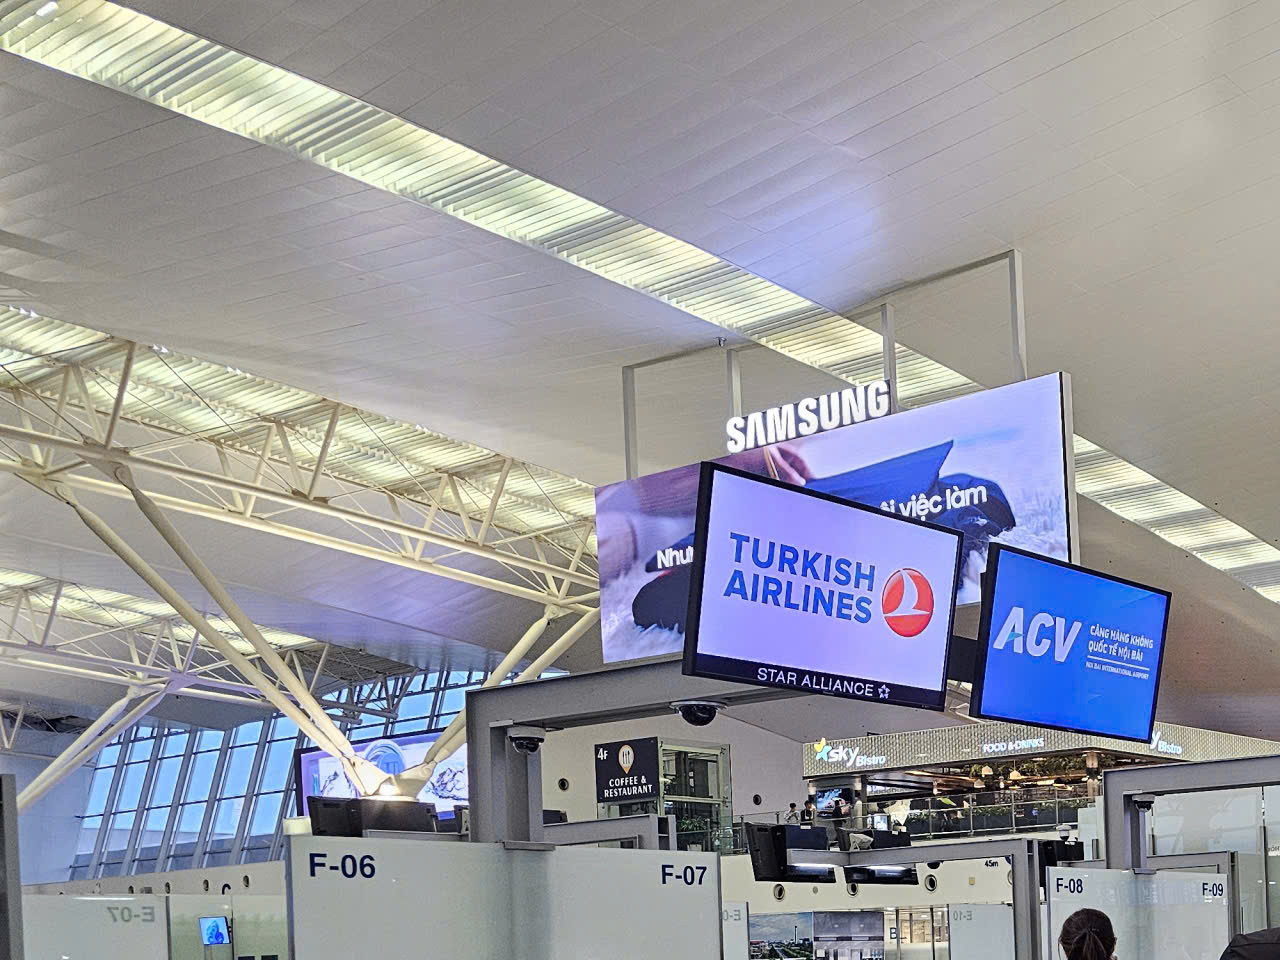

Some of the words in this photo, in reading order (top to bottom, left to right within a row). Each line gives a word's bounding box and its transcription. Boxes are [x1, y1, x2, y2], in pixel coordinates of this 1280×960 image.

[725, 380, 891, 454] SAMSUNG
[899, 493, 943, 521] việc
[945, 485, 988, 510] làm
[729, 531, 876, 592] TURKISH
[723, 569, 873, 624] AIRLINES
[993, 606, 1082, 663] ACV
[1110, 629, 1130, 644] HÀNG
[1130, 633, 1154, 649] KHÔNG
[1088, 639, 1107, 655] QUỐC
[757, 666, 797, 686] STAR
[801, 670, 874, 697] ALLIANCE
[597, 747, 608, 760] 4F
[983, 743, 1005, 753] FOOD
[1016, 738, 1044, 749] DRINKS
[1158, 741, 1182, 755] Bistro
[828, 746, 859, 768] sky
[856, 754, 885, 766] Bistro
[604, 784, 652, 798] RESTAURANT
[609, 776, 638, 787] COFFEE
[641, 775, 647, 784] &
[309, 853, 376, 880] F-06
[661, 865, 708, 886] F-07
[1056, 878, 1083, 894] F-08
[1202, 882, 1224, 897] F-09
[890, 927, 897, 939] B
